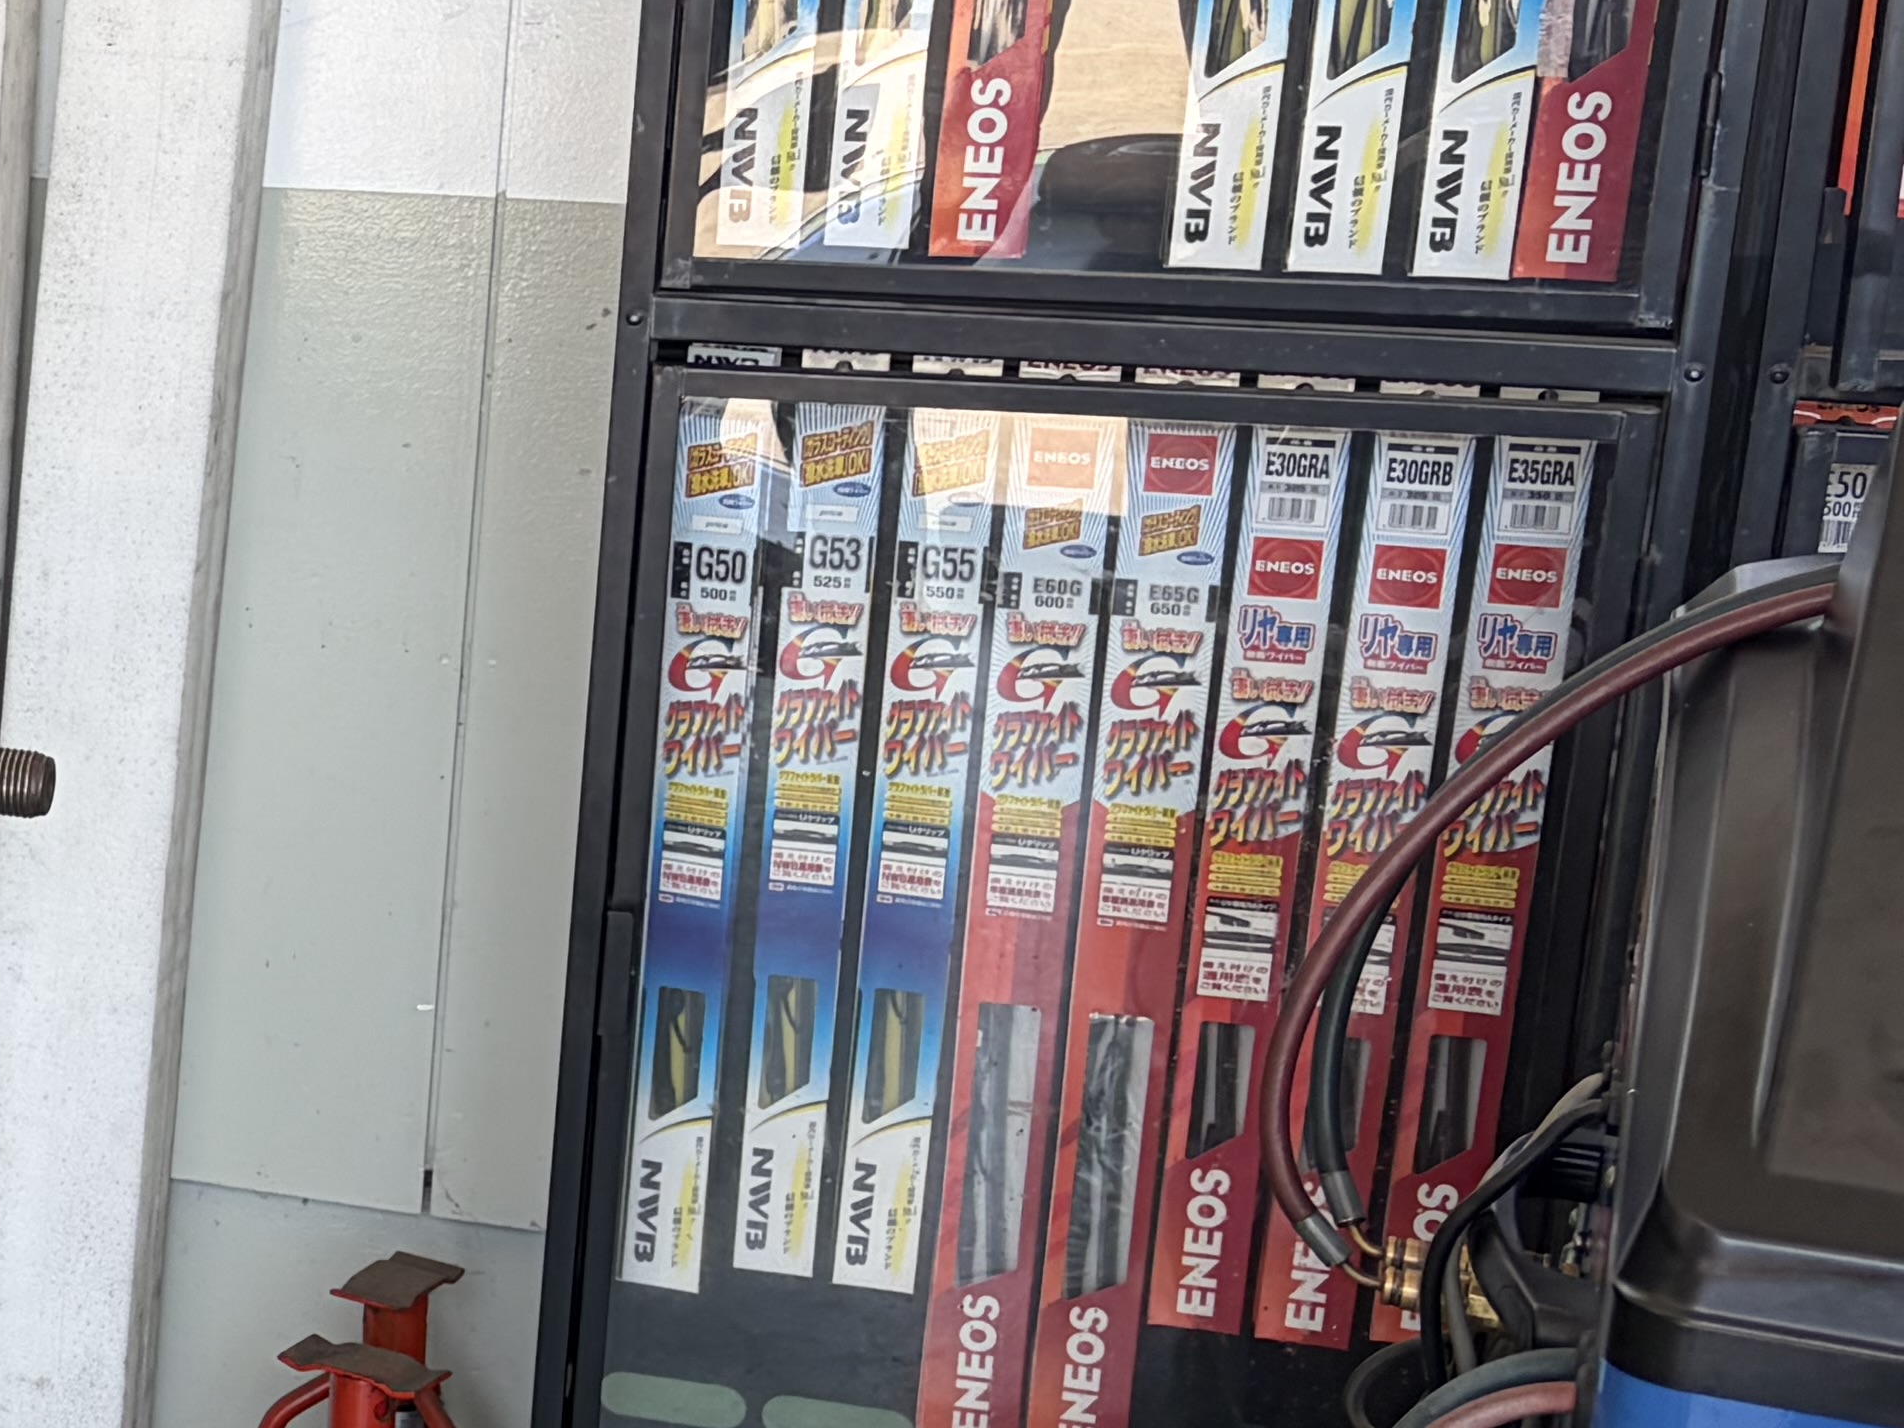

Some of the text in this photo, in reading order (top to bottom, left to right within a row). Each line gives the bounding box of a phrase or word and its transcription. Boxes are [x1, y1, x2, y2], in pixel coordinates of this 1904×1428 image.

[728, 107, 759, 224] NWB
[956, 76, 1012, 243] ENEOS
[1545, 90, 1613, 264] ENEOS
[1183, 122, 1222, 245] NWB
[1303, 125, 1342, 249] NWB
[1428, 129, 1469, 254] NWB
[1033, 450, 1092, 466] ENEOS
[1150, 456, 1210, 471] ENEOS
[1265, 452, 1331, 480] E30GRA
[1386, 458, 1454, 487] E30GRB
[1507, 458, 1576, 487] E35GRA
[696, 546, 746, 584] G50
[808, 535, 861, 571] G53
[922, 545, 975, 582] G55
[1254, 559, 1316, 576] ENEOS
[1495, 567, 1558, 584] ENEOS
[700, 588, 728, 601] 500
[813, 575, 842, 589] 525
[926, 585, 954, 600] 550
[1032, 578, 1082, 597] E60G
[1149, 585, 1200, 604] E65G
[1376, 568, 1439, 585] ENEOS
[1035, 596, 1064, 609] 600
[1150, 603, 1181, 616] 650
[774, 679, 859, 730] グラファイト
[886, 690, 973, 739] グラファイト
[992, 701, 1082, 753] グラファイト
[662, 730, 741, 776] ワイパー
[773, 719, 858, 766] ワイパー
[883, 732, 968, 777] ワイパー
[1105, 710, 1196, 761] グラファイト
[989, 743, 1077, 790] ワイパー
[1103, 750, 1193, 798] ワイパー
[1211, 759, 1306, 809] グラファイト
[1208, 804, 1300, 847] ワイパー
[1326, 813, 1403, 857] ワイパ
[1442, 810, 1539, 858] ワイパー
[634, 1158, 663, 1264] NWB
[745, 1147, 774, 1251] NWB
[845, 1158, 878, 1267] NWB
[1176, 1168, 1232, 1318] ENEOS
